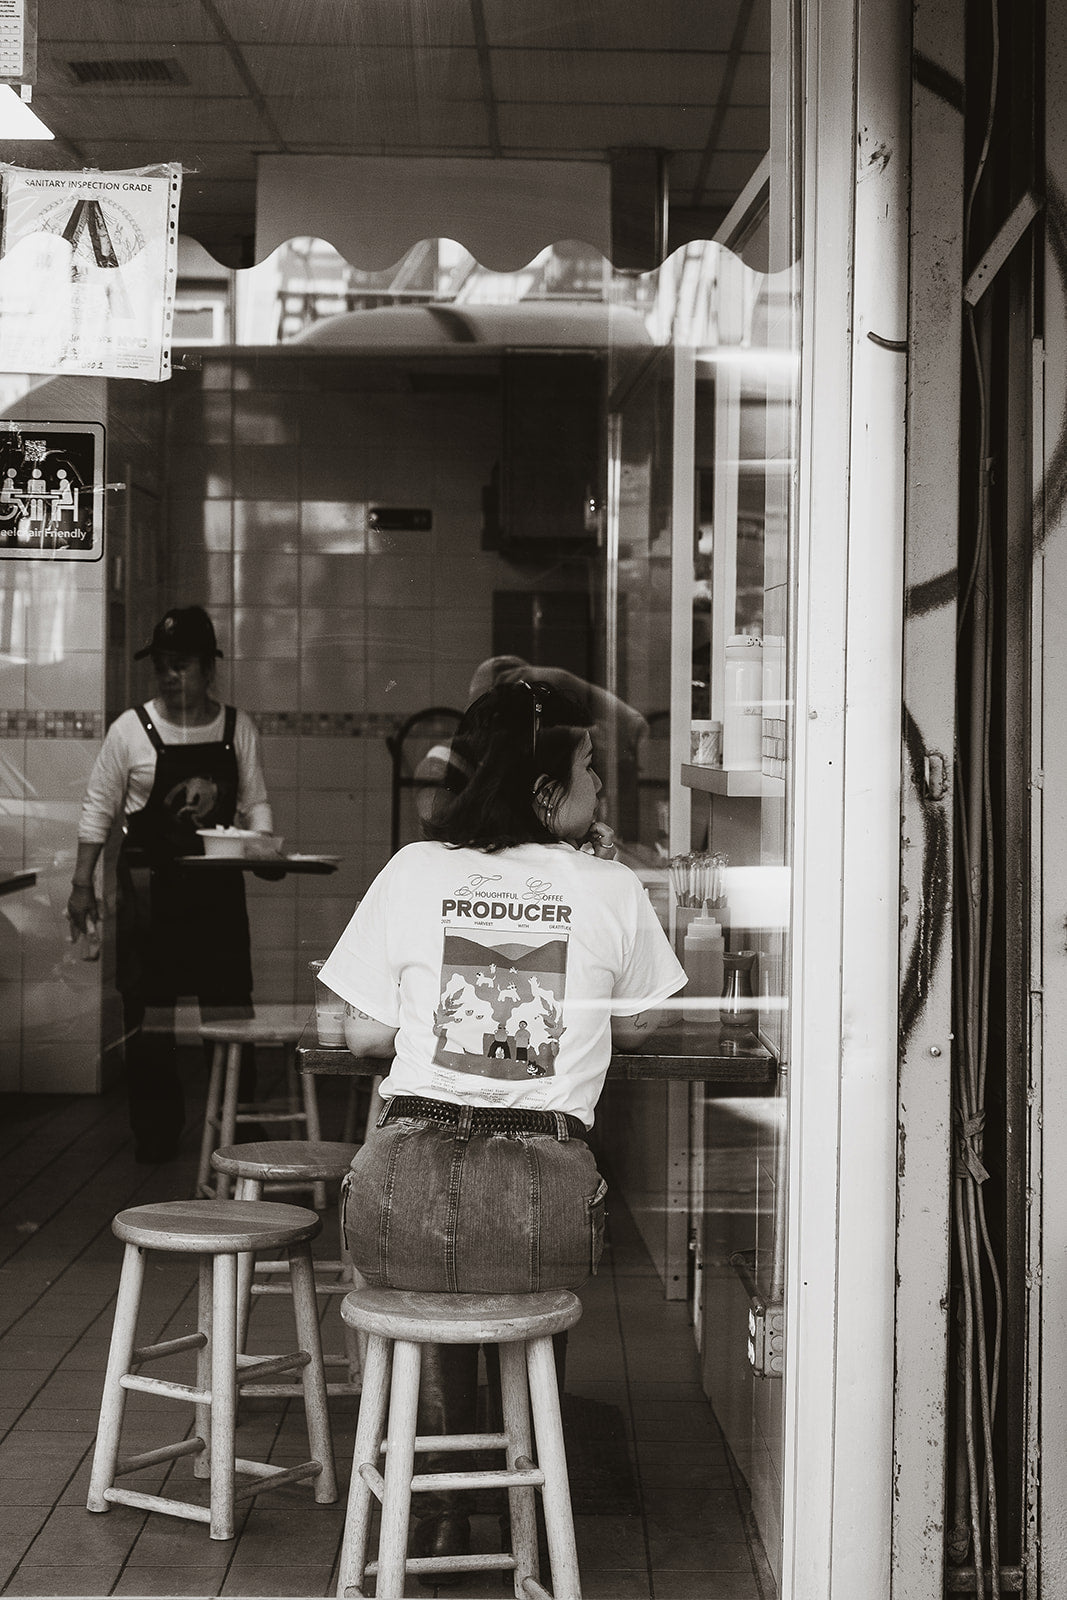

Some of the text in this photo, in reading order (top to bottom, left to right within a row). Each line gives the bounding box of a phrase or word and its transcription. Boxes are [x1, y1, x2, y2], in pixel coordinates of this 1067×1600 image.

[25, 179, 153, 192] SANITARY INSPECTION GRADE
[44, 528, 87, 541] Friendly
[453, 873, 564, 905] THOUGHTFUL COFFEE
[441, 899, 573, 923] PRODUCER
